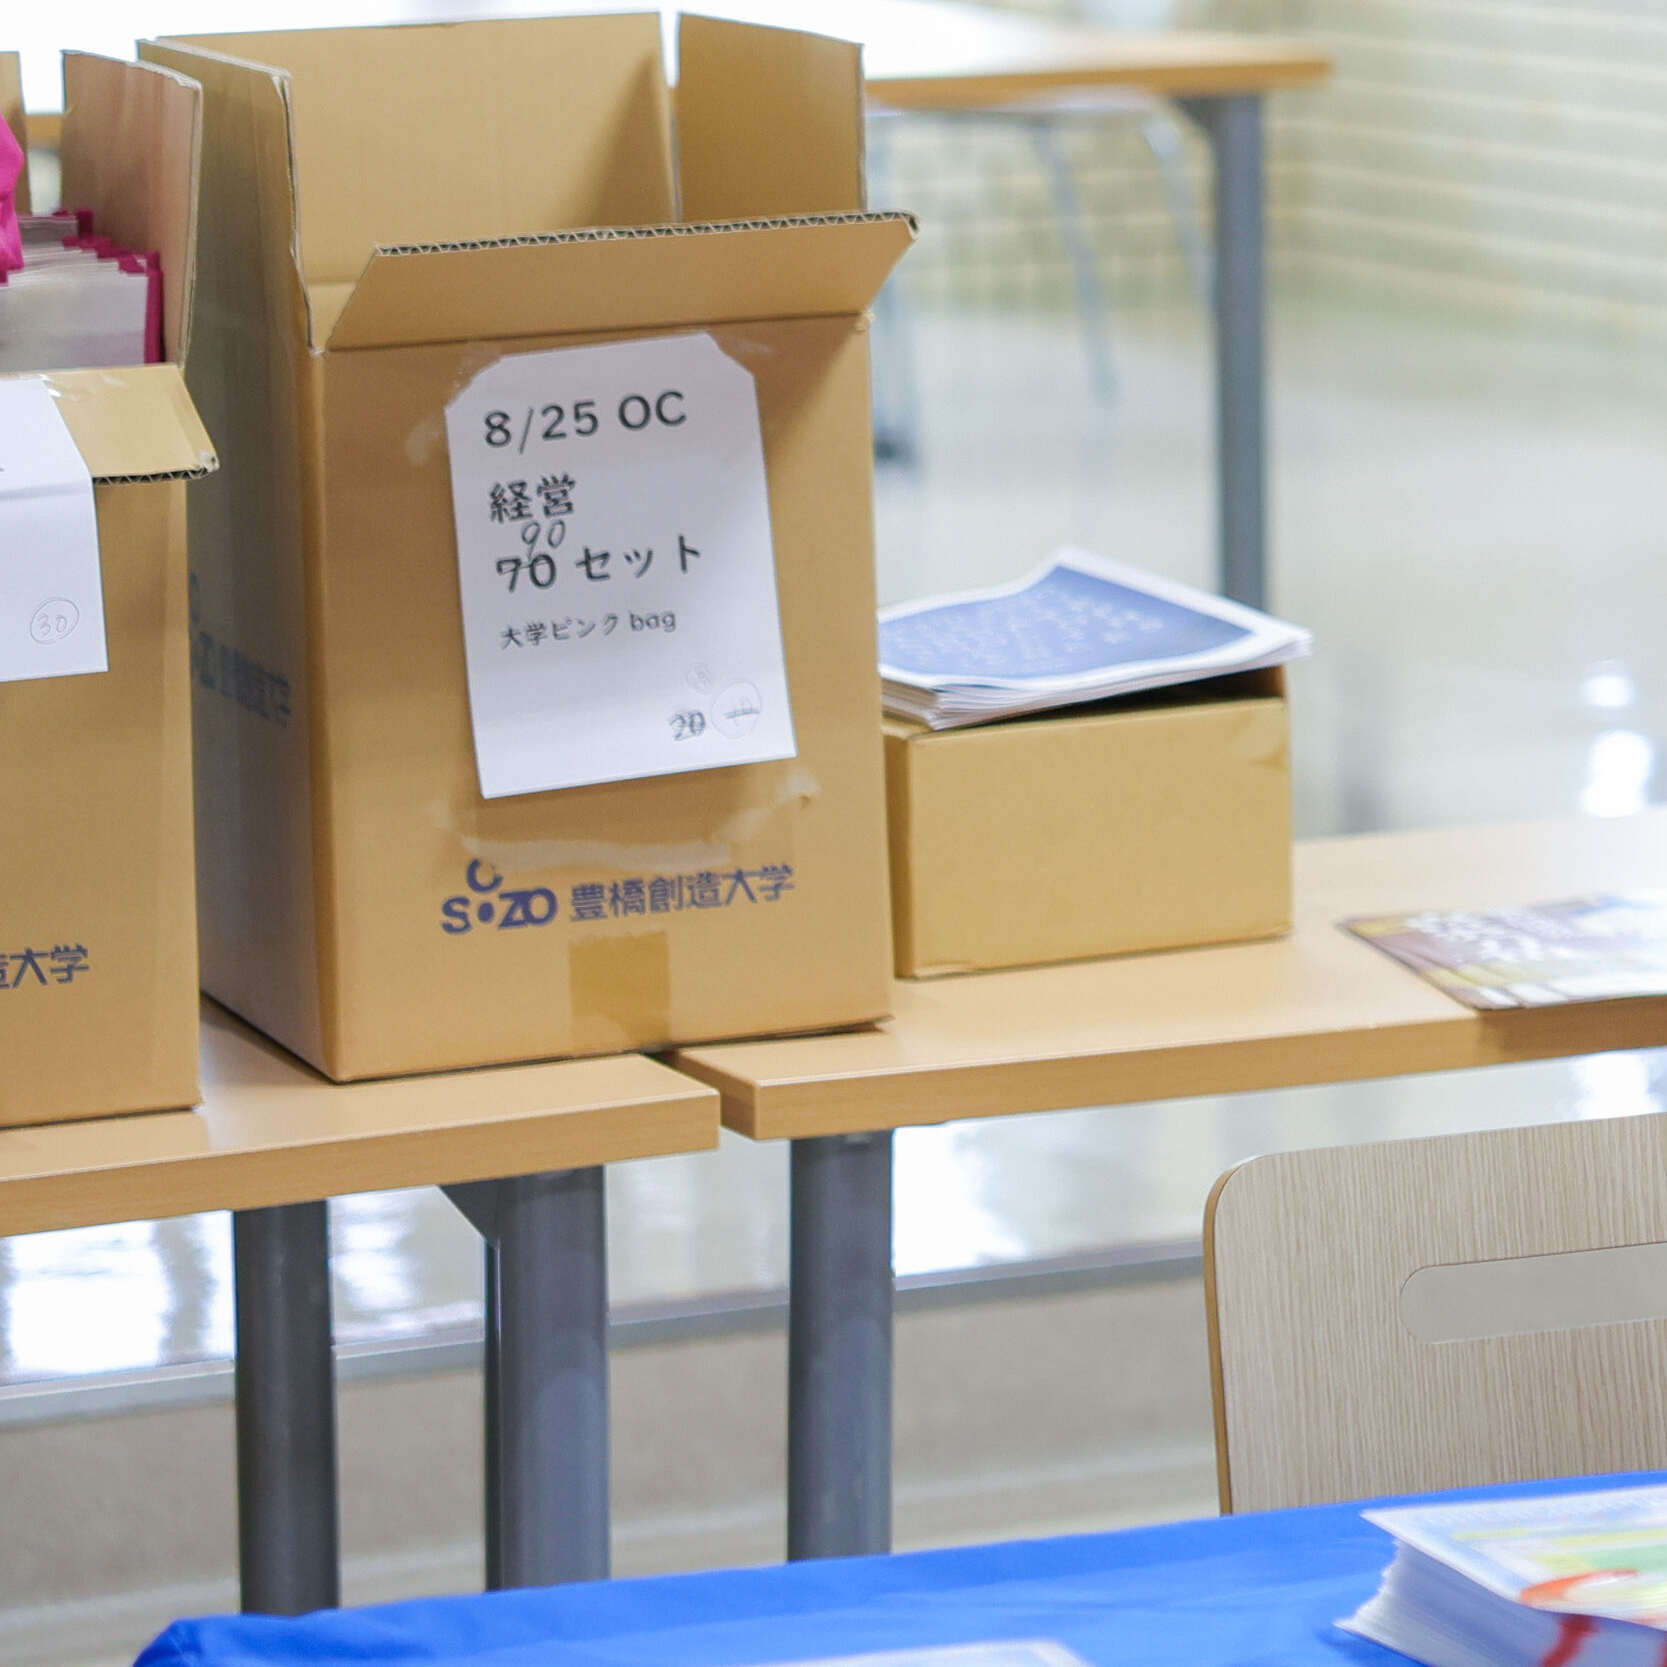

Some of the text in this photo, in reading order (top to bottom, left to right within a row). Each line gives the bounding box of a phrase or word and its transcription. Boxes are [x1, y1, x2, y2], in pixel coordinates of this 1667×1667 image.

[484, 389, 687, 455] 8/25 OC
[489, 472, 577, 524] 経営
[496, 533, 701, 593] 70 セット
[521, 519, 566, 562] 90
[37, 613, 68, 637] 30
[501, 610, 677, 650] 大学ピンク bag
[569, 863, 795, 923] 豊橋創造大学
